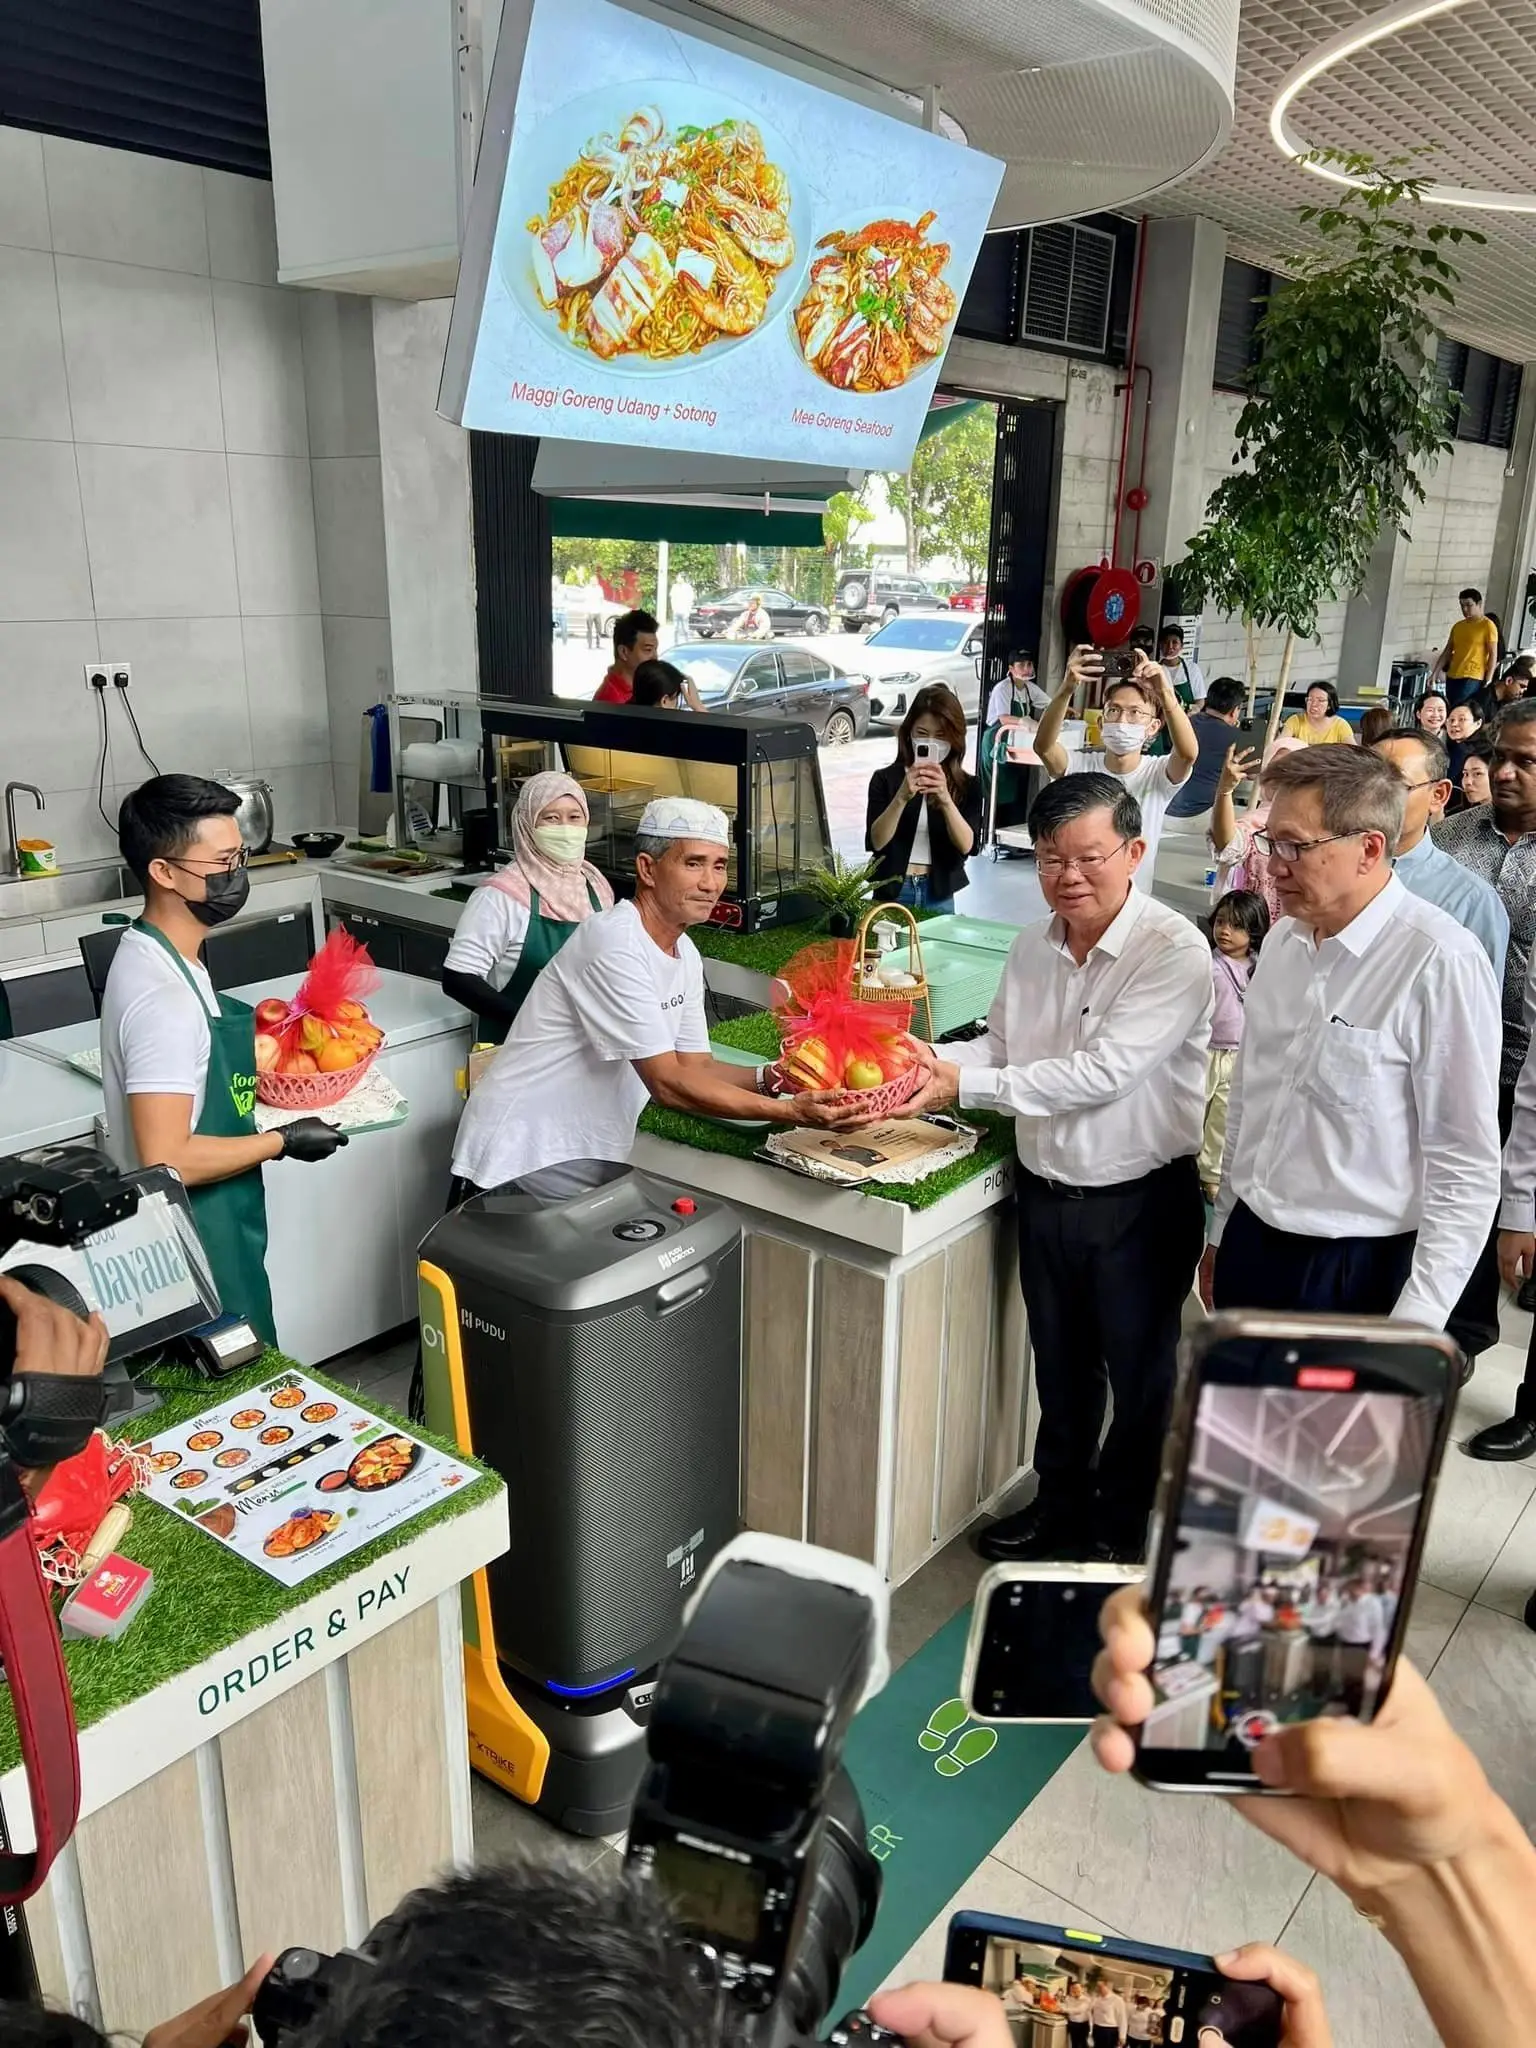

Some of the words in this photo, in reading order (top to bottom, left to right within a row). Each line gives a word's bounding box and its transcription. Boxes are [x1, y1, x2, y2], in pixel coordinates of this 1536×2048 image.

[511, 381, 559, 408] Maggi
[562, 388, 614, 415] Goreng
[617, 396, 660, 421] Udang
[673, 403, 717, 427] Sotong
[791, 408, 815, 425] Mee
[816, 412, 853, 434] Goreng
[854, 418, 894, 437] Seafood
[83, 1236, 188, 1317] bayana
[422, 1323, 446, 1355] 01
[475, 1318, 506, 1341] PUDU
[235, 1489, 280, 1516] Menu
[198, 1626, 315, 1715] ORDER
[327, 1608, 347, 1638] &
[357, 1565, 410, 1620] PAY
[868, 1824, 904, 1862] ER
